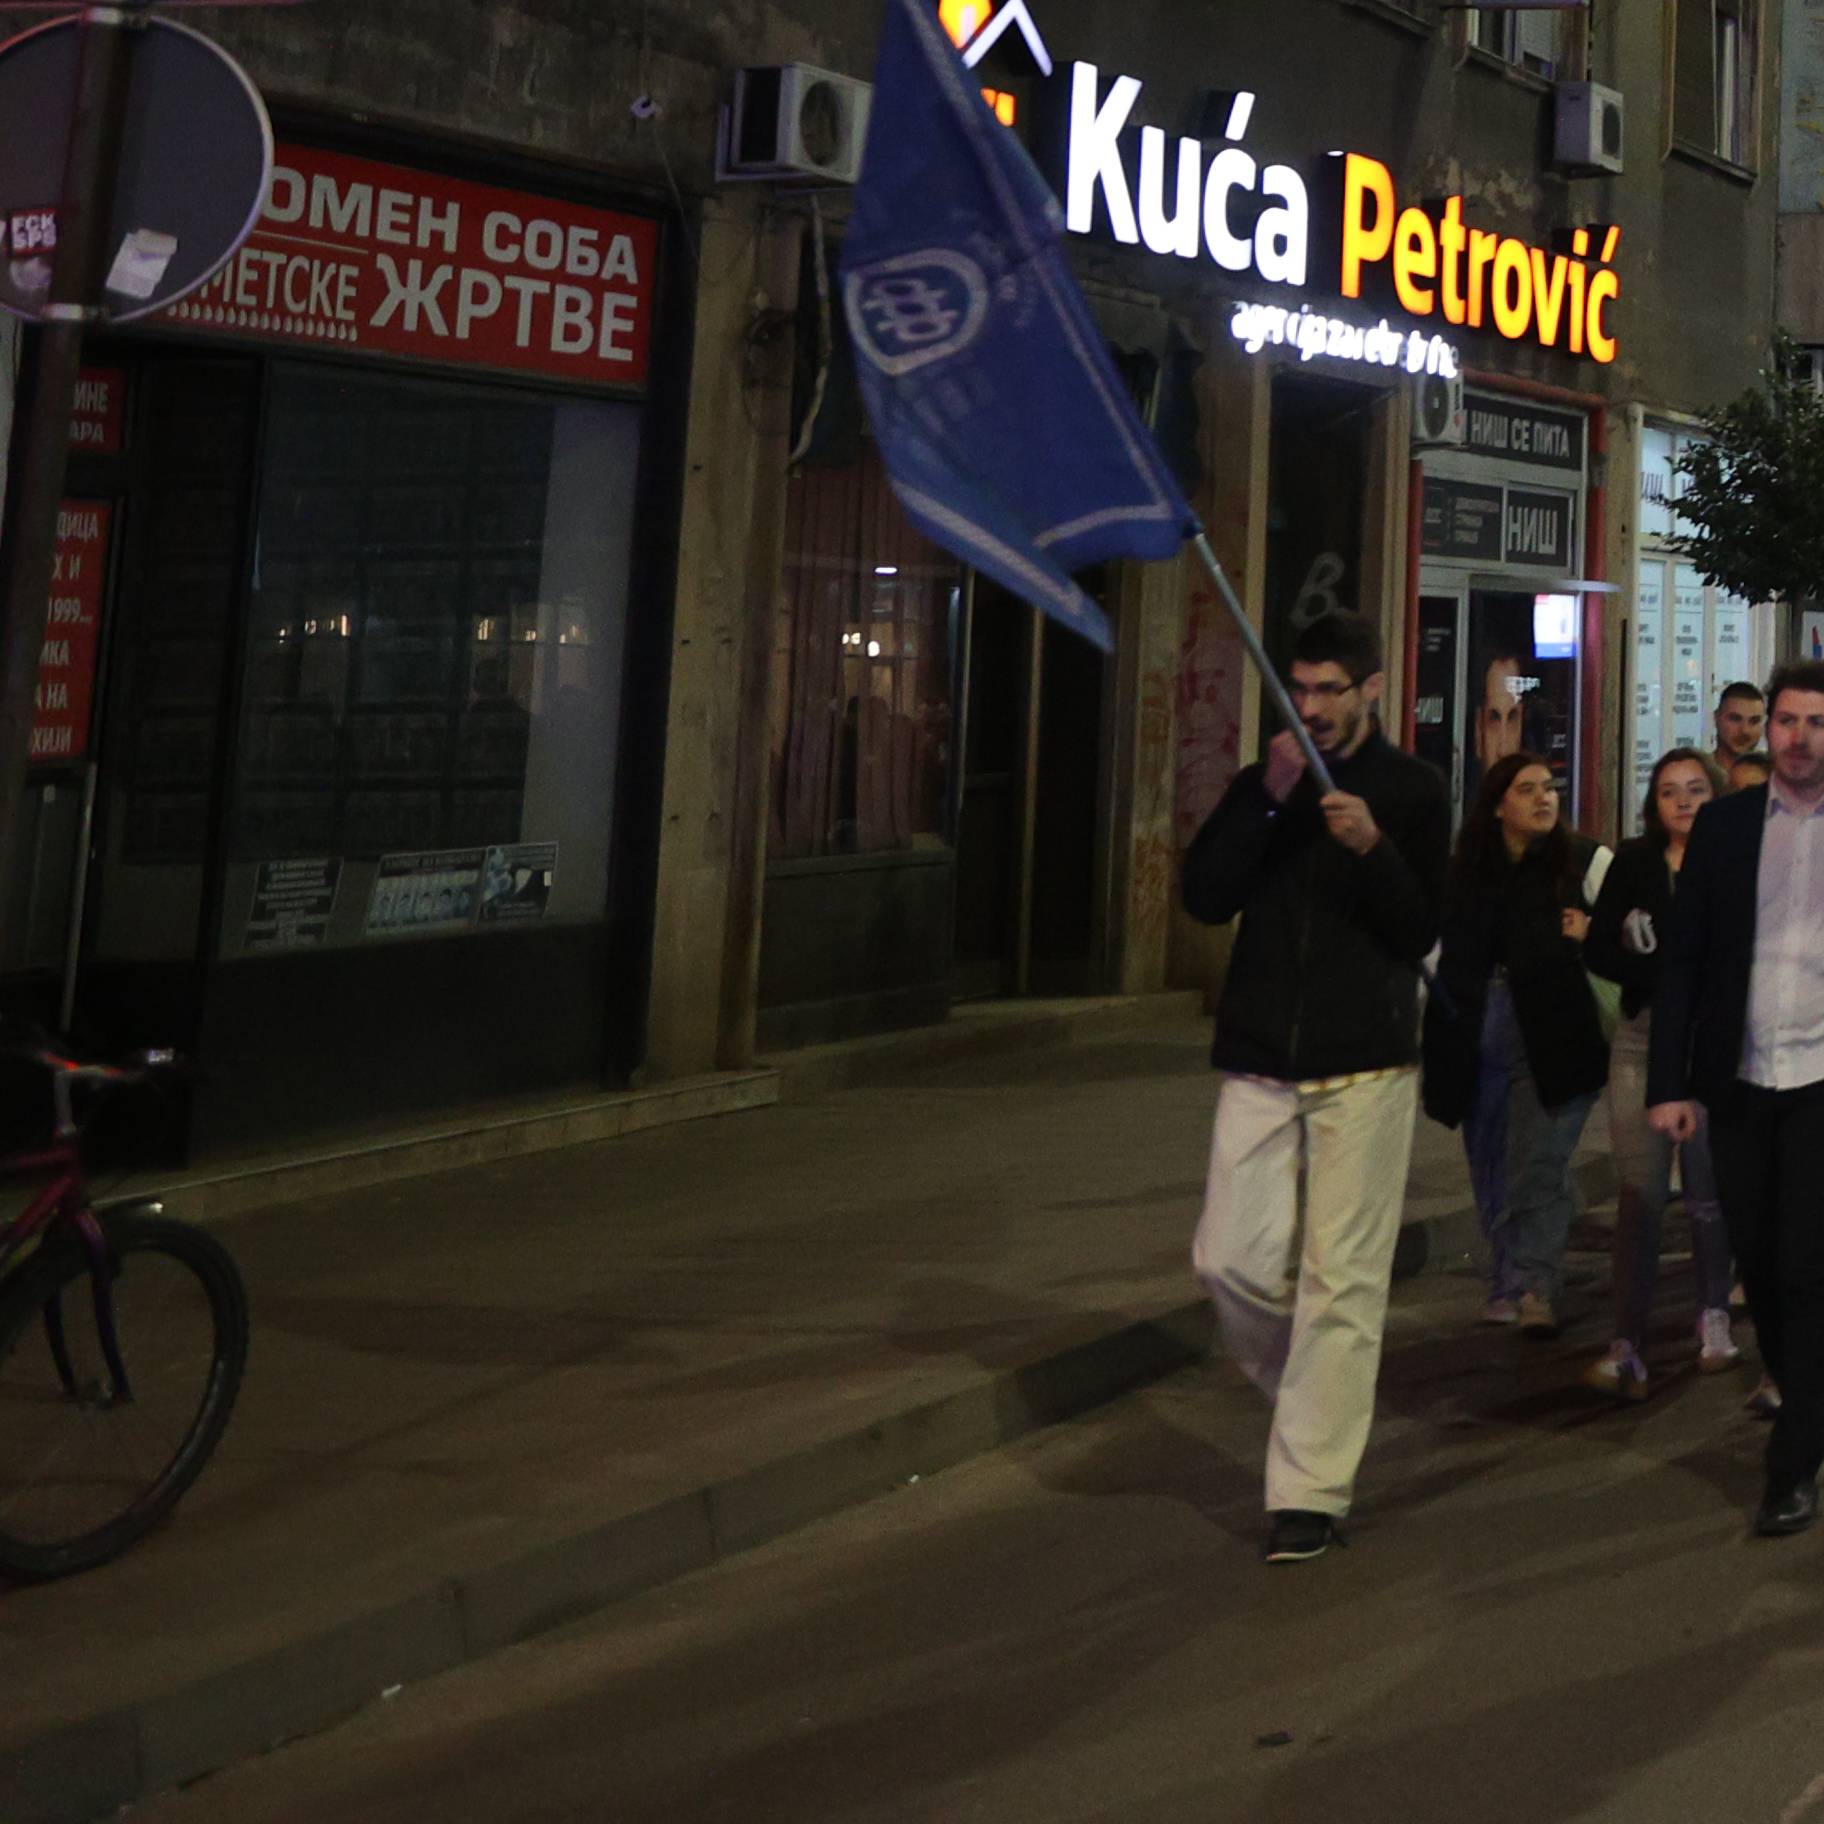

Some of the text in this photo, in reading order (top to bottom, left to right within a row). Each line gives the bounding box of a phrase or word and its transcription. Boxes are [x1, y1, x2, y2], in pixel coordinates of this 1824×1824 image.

[482, 211, 639, 285] СОБА
[1066, 60, 1621, 364] Kuća Petrović
[369, 252, 639, 363] ЖРТВЕ
[1470, 409, 1570, 459] НИШ СЕ ПИТА
[1507, 505, 1559, 555] НИШ
